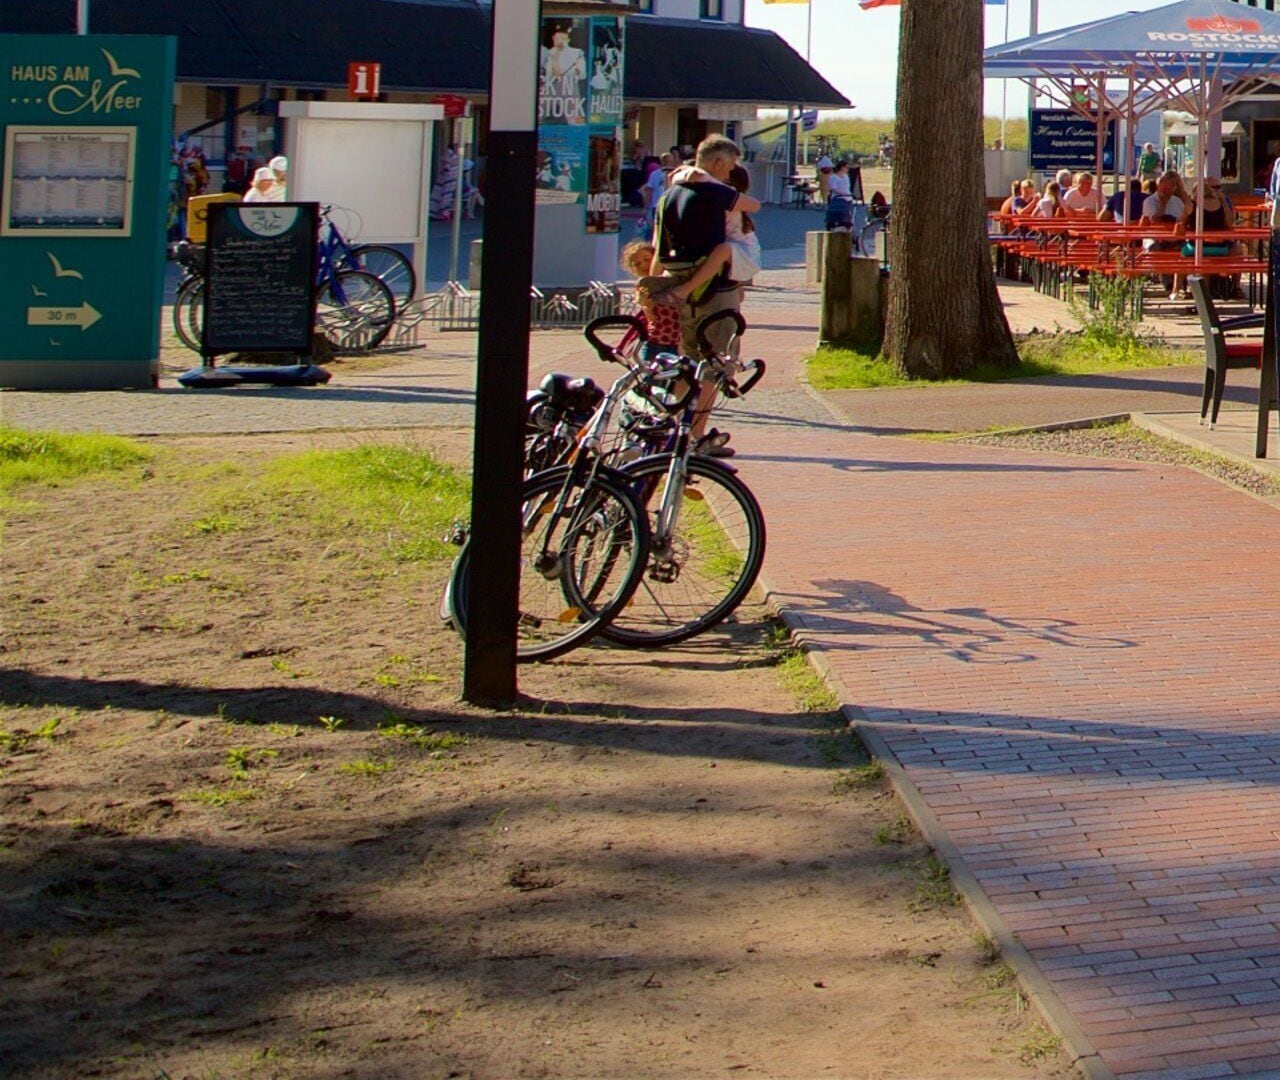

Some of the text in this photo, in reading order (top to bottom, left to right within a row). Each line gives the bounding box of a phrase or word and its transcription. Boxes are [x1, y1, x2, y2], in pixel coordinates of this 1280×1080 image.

[12, 65, 90, 82] HAUS AM
[47, 78, 142, 115] Meer
[47, 310, 77, 321] 30 m
